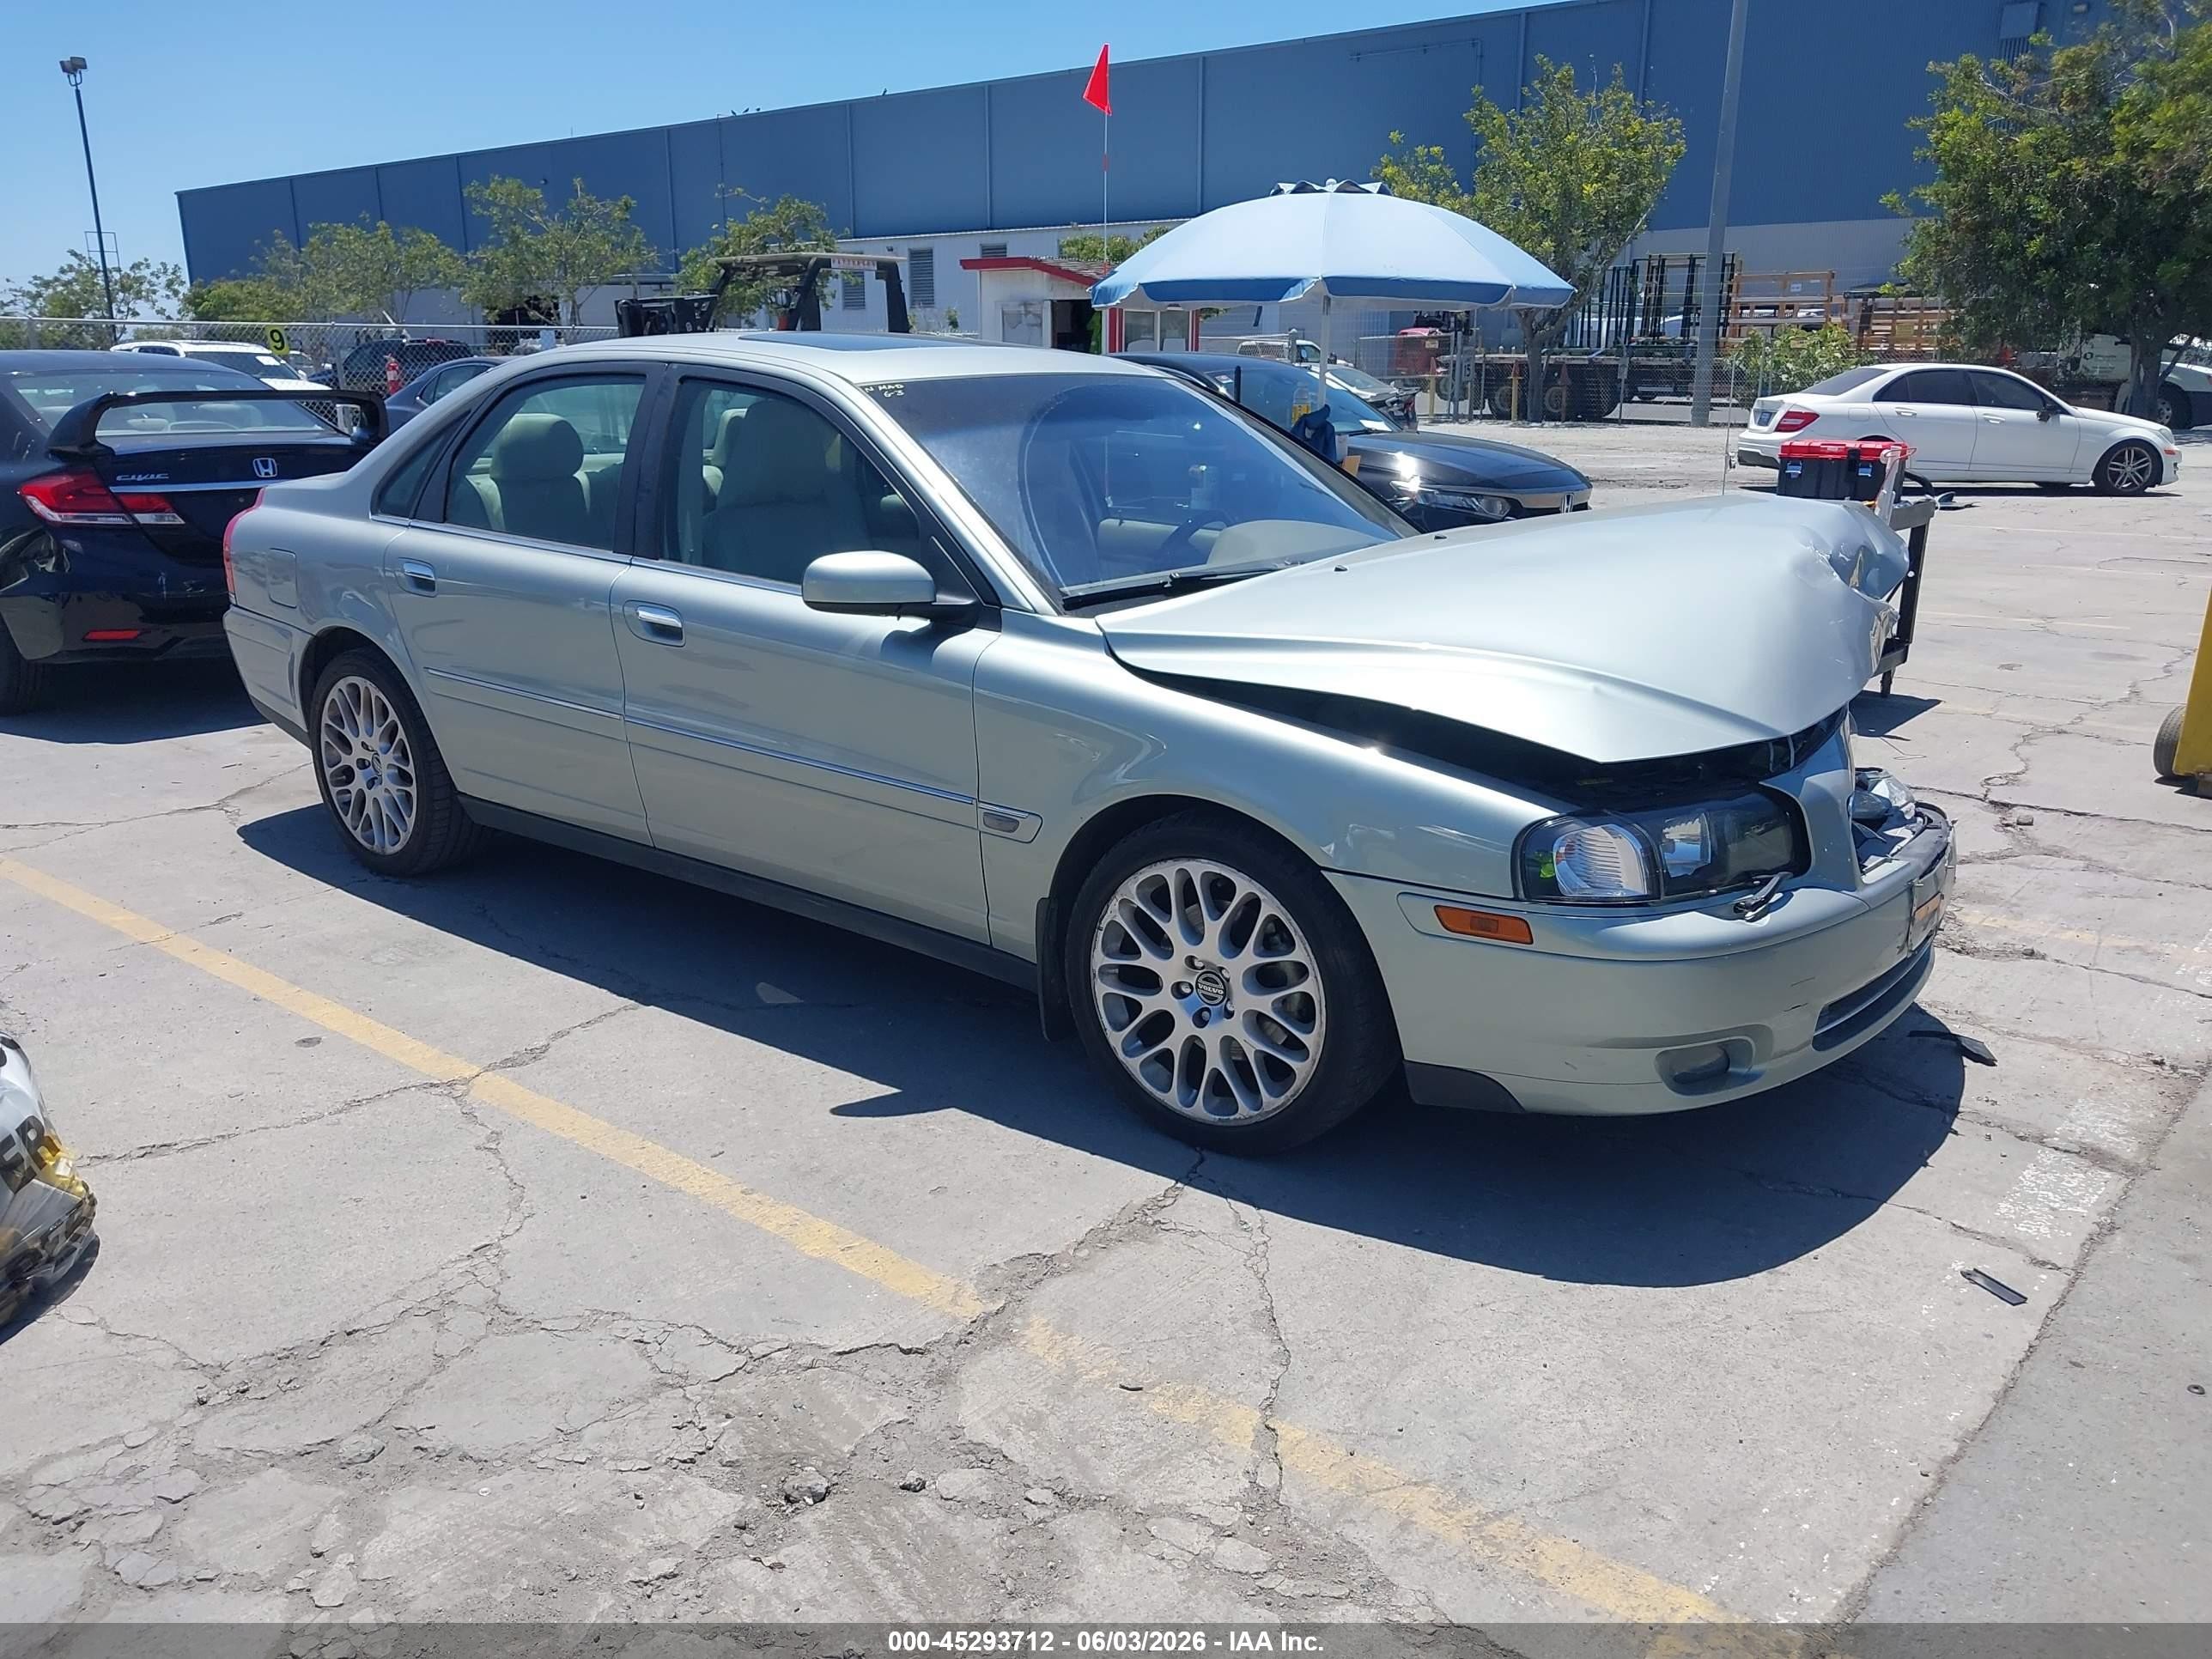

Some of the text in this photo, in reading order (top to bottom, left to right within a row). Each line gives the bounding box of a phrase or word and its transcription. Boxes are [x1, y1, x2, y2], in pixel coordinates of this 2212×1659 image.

[270, 329, 285, 350] 9
[116, 473, 169, 482] CIVIC
[1198, 982, 1224, 995] VOLVO
